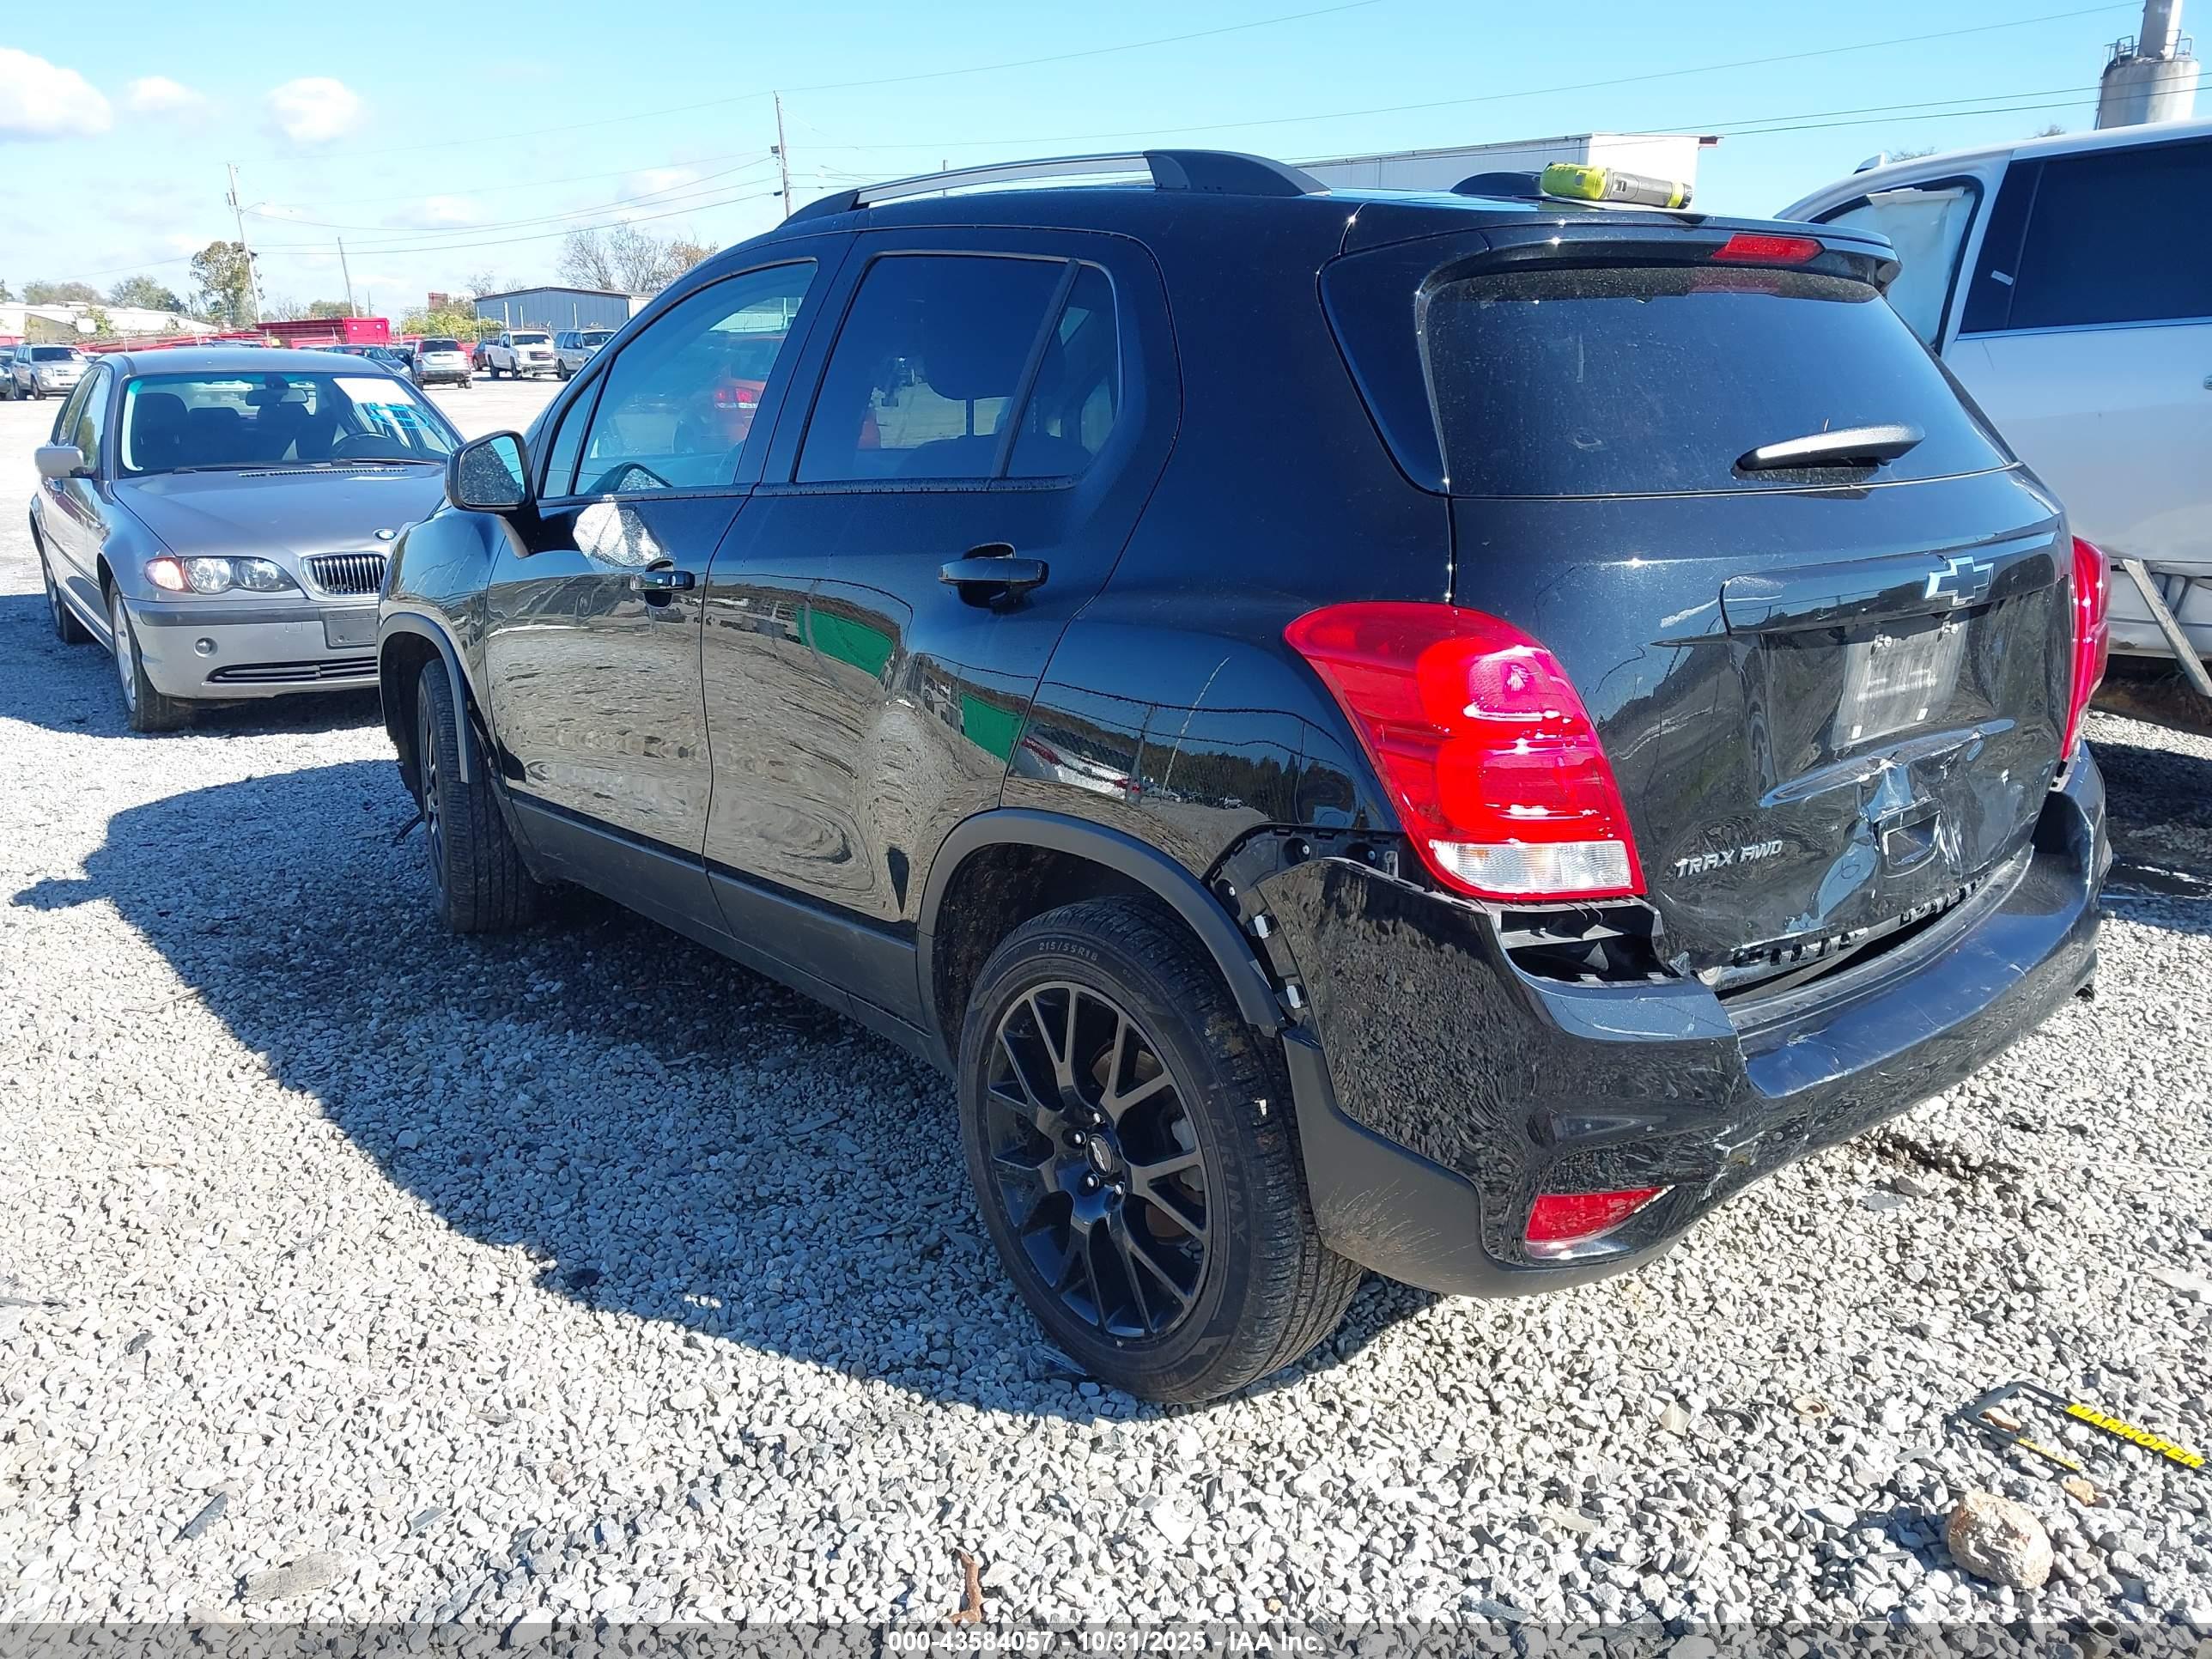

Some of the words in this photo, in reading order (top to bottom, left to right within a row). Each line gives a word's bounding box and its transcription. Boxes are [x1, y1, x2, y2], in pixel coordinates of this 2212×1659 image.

[1674, 849, 1735, 878] TRAX
[1740, 840, 1784, 863] AWD
[1038, 941, 1098, 962] 215/55R18
[2065, 1403, 2206, 1469] MARHOFER
